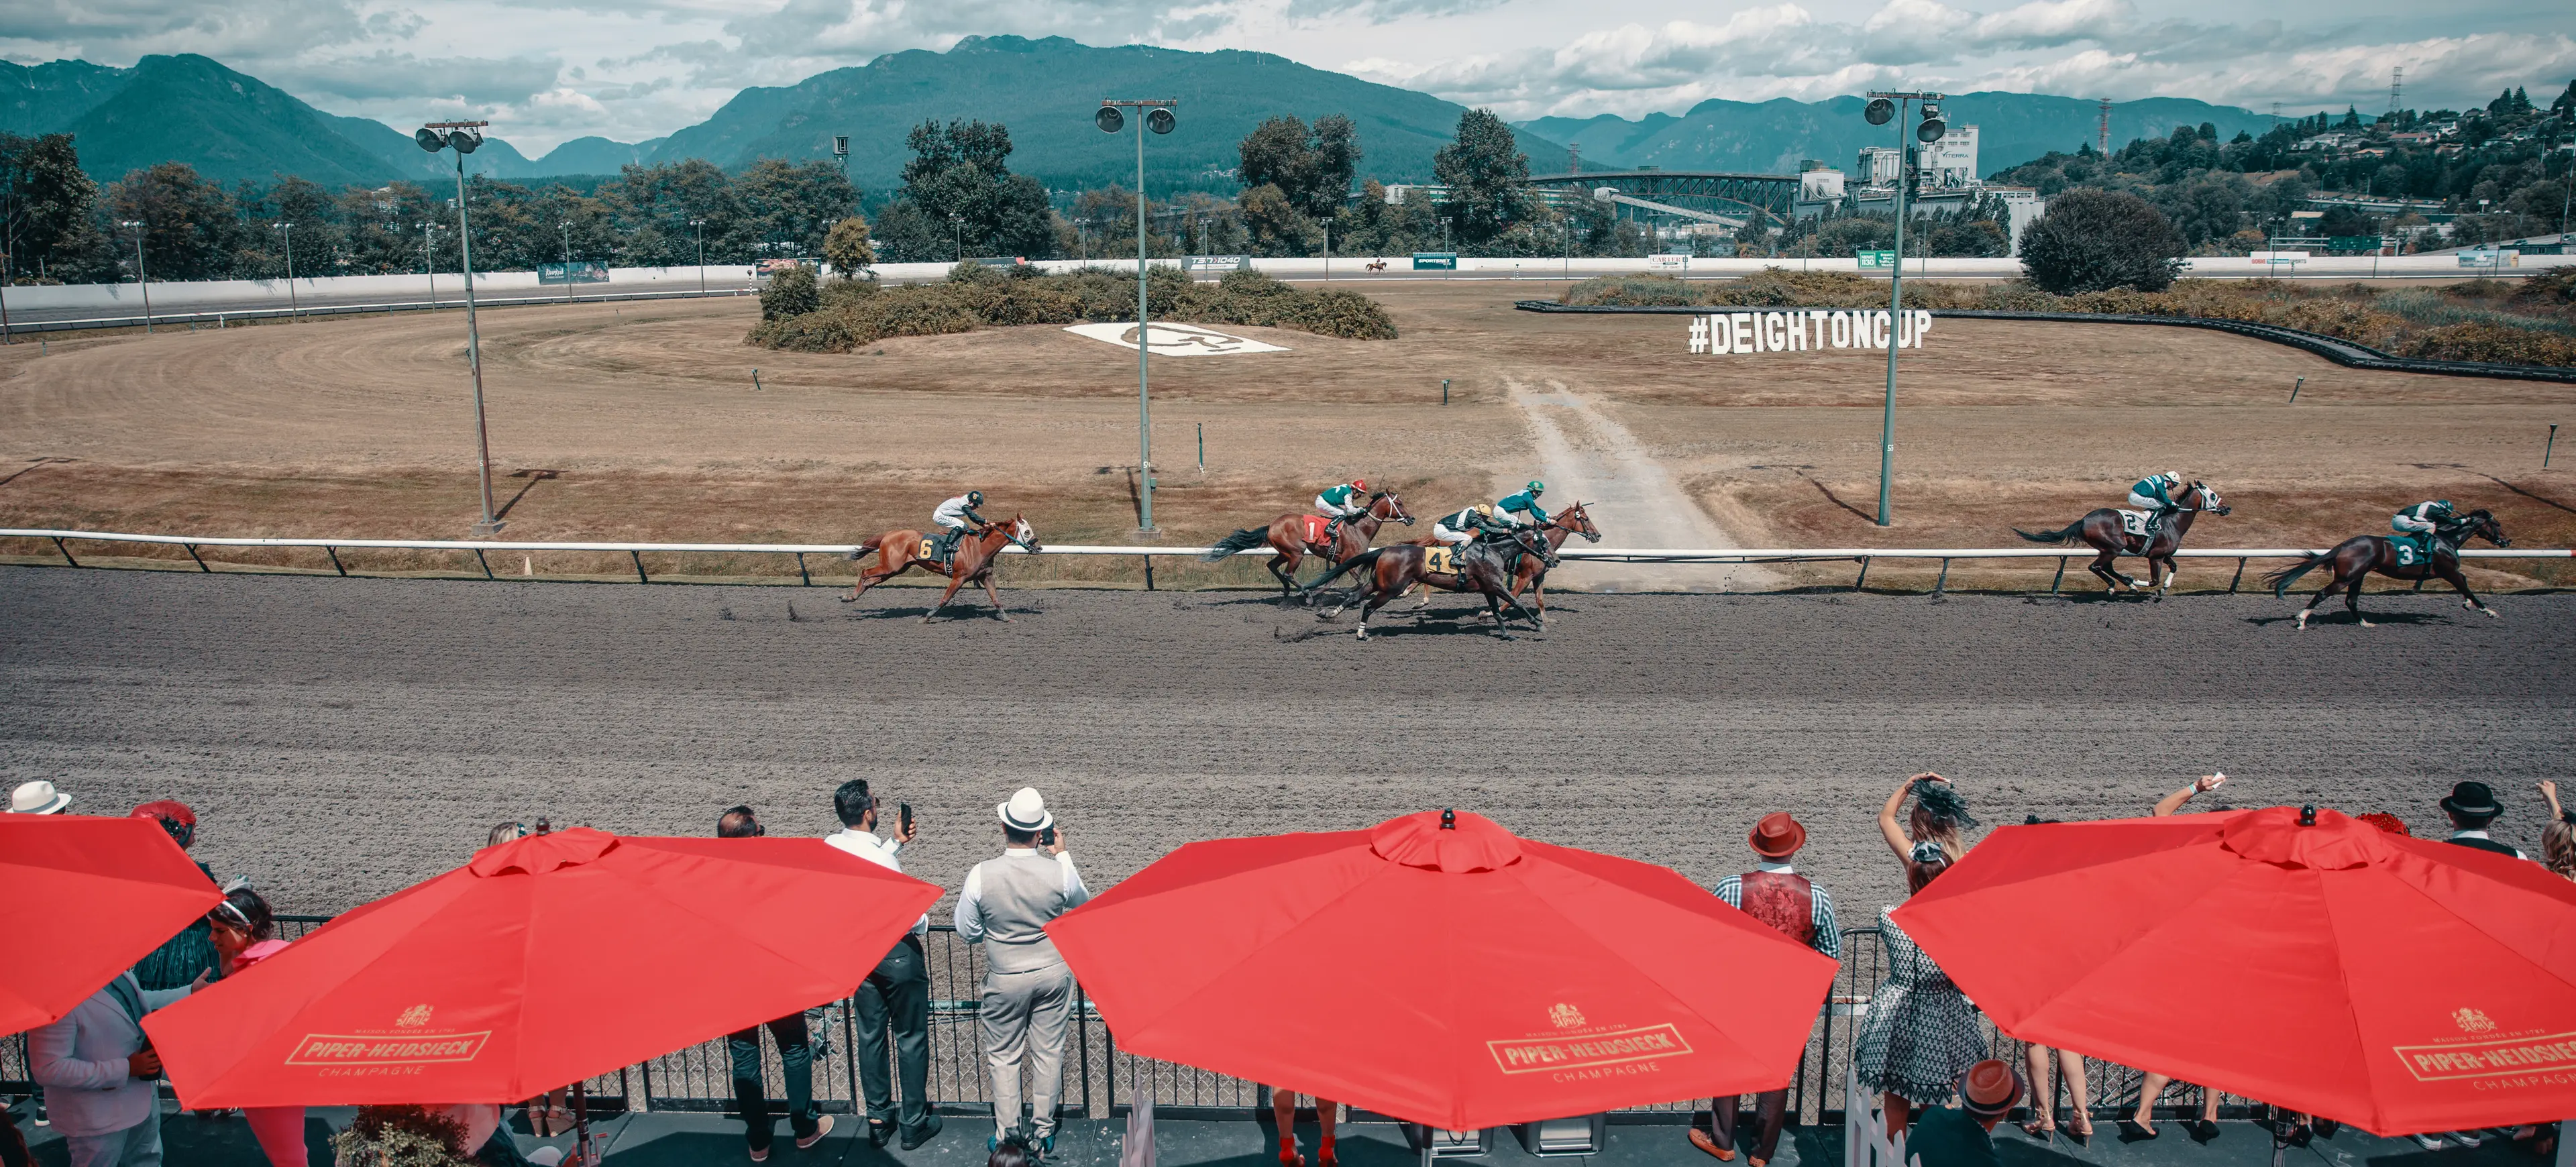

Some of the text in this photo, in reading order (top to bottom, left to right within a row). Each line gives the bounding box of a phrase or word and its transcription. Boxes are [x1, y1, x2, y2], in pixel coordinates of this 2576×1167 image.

[1688, 310, 1932, 355] #DEIGHTONCUP
[1308, 522, 1315, 541] 1
[2125, 514, 2135, 531] 2
[919, 539, 934, 559] 6
[2399, 545, 2414, 565] 3
[1428, 553, 1442, 571] 4
[304, 1040, 474, 1058] PIPER-HEIDSIECK
[1505, 1032, 1676, 1066] PIPER-HEIDSIECK
[2413, 1040, 2576, 1072] PIPER-HEIDSIE
[318, 1066, 426, 1077] CHAMPAGNE
[1553, 1062, 1660, 1083] CHAMPAGNE
[2473, 1072, 2576, 1091] CHAMPAGN
